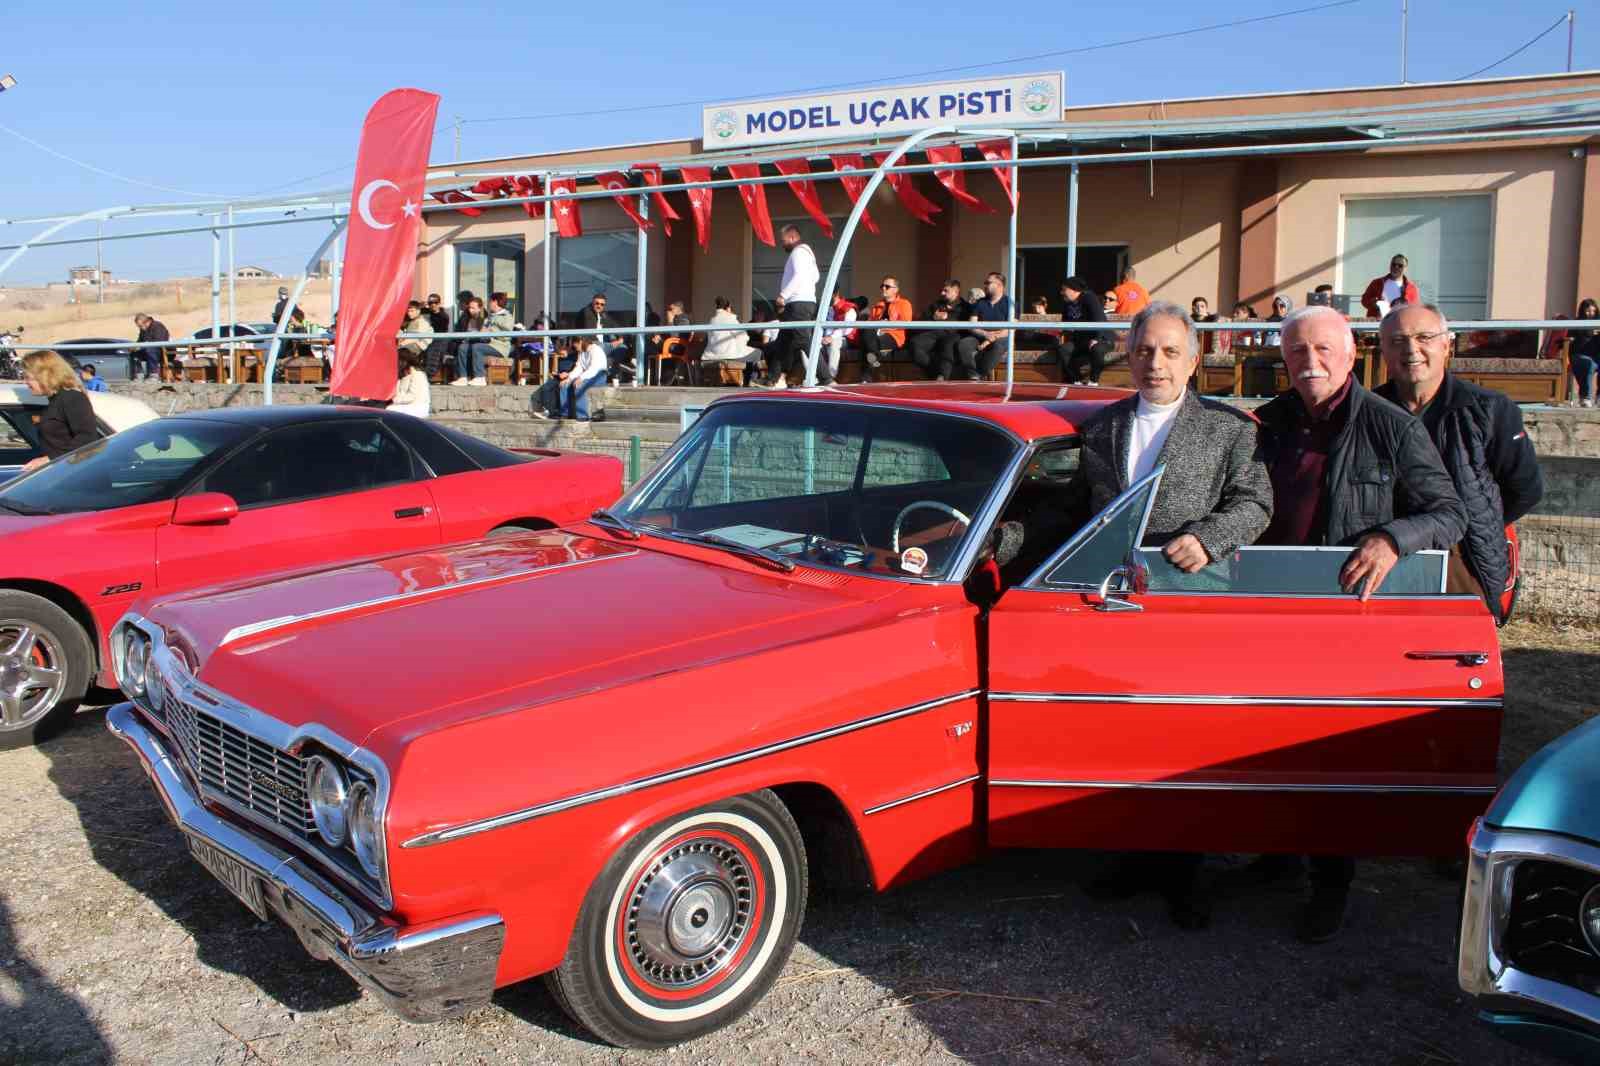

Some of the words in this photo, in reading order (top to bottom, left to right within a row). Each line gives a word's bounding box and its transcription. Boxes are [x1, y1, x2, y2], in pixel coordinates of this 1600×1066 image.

[746, 105, 841, 134] MODEL
[848, 96, 930, 127] UÇAK
[101, 582, 142, 596] Z28
